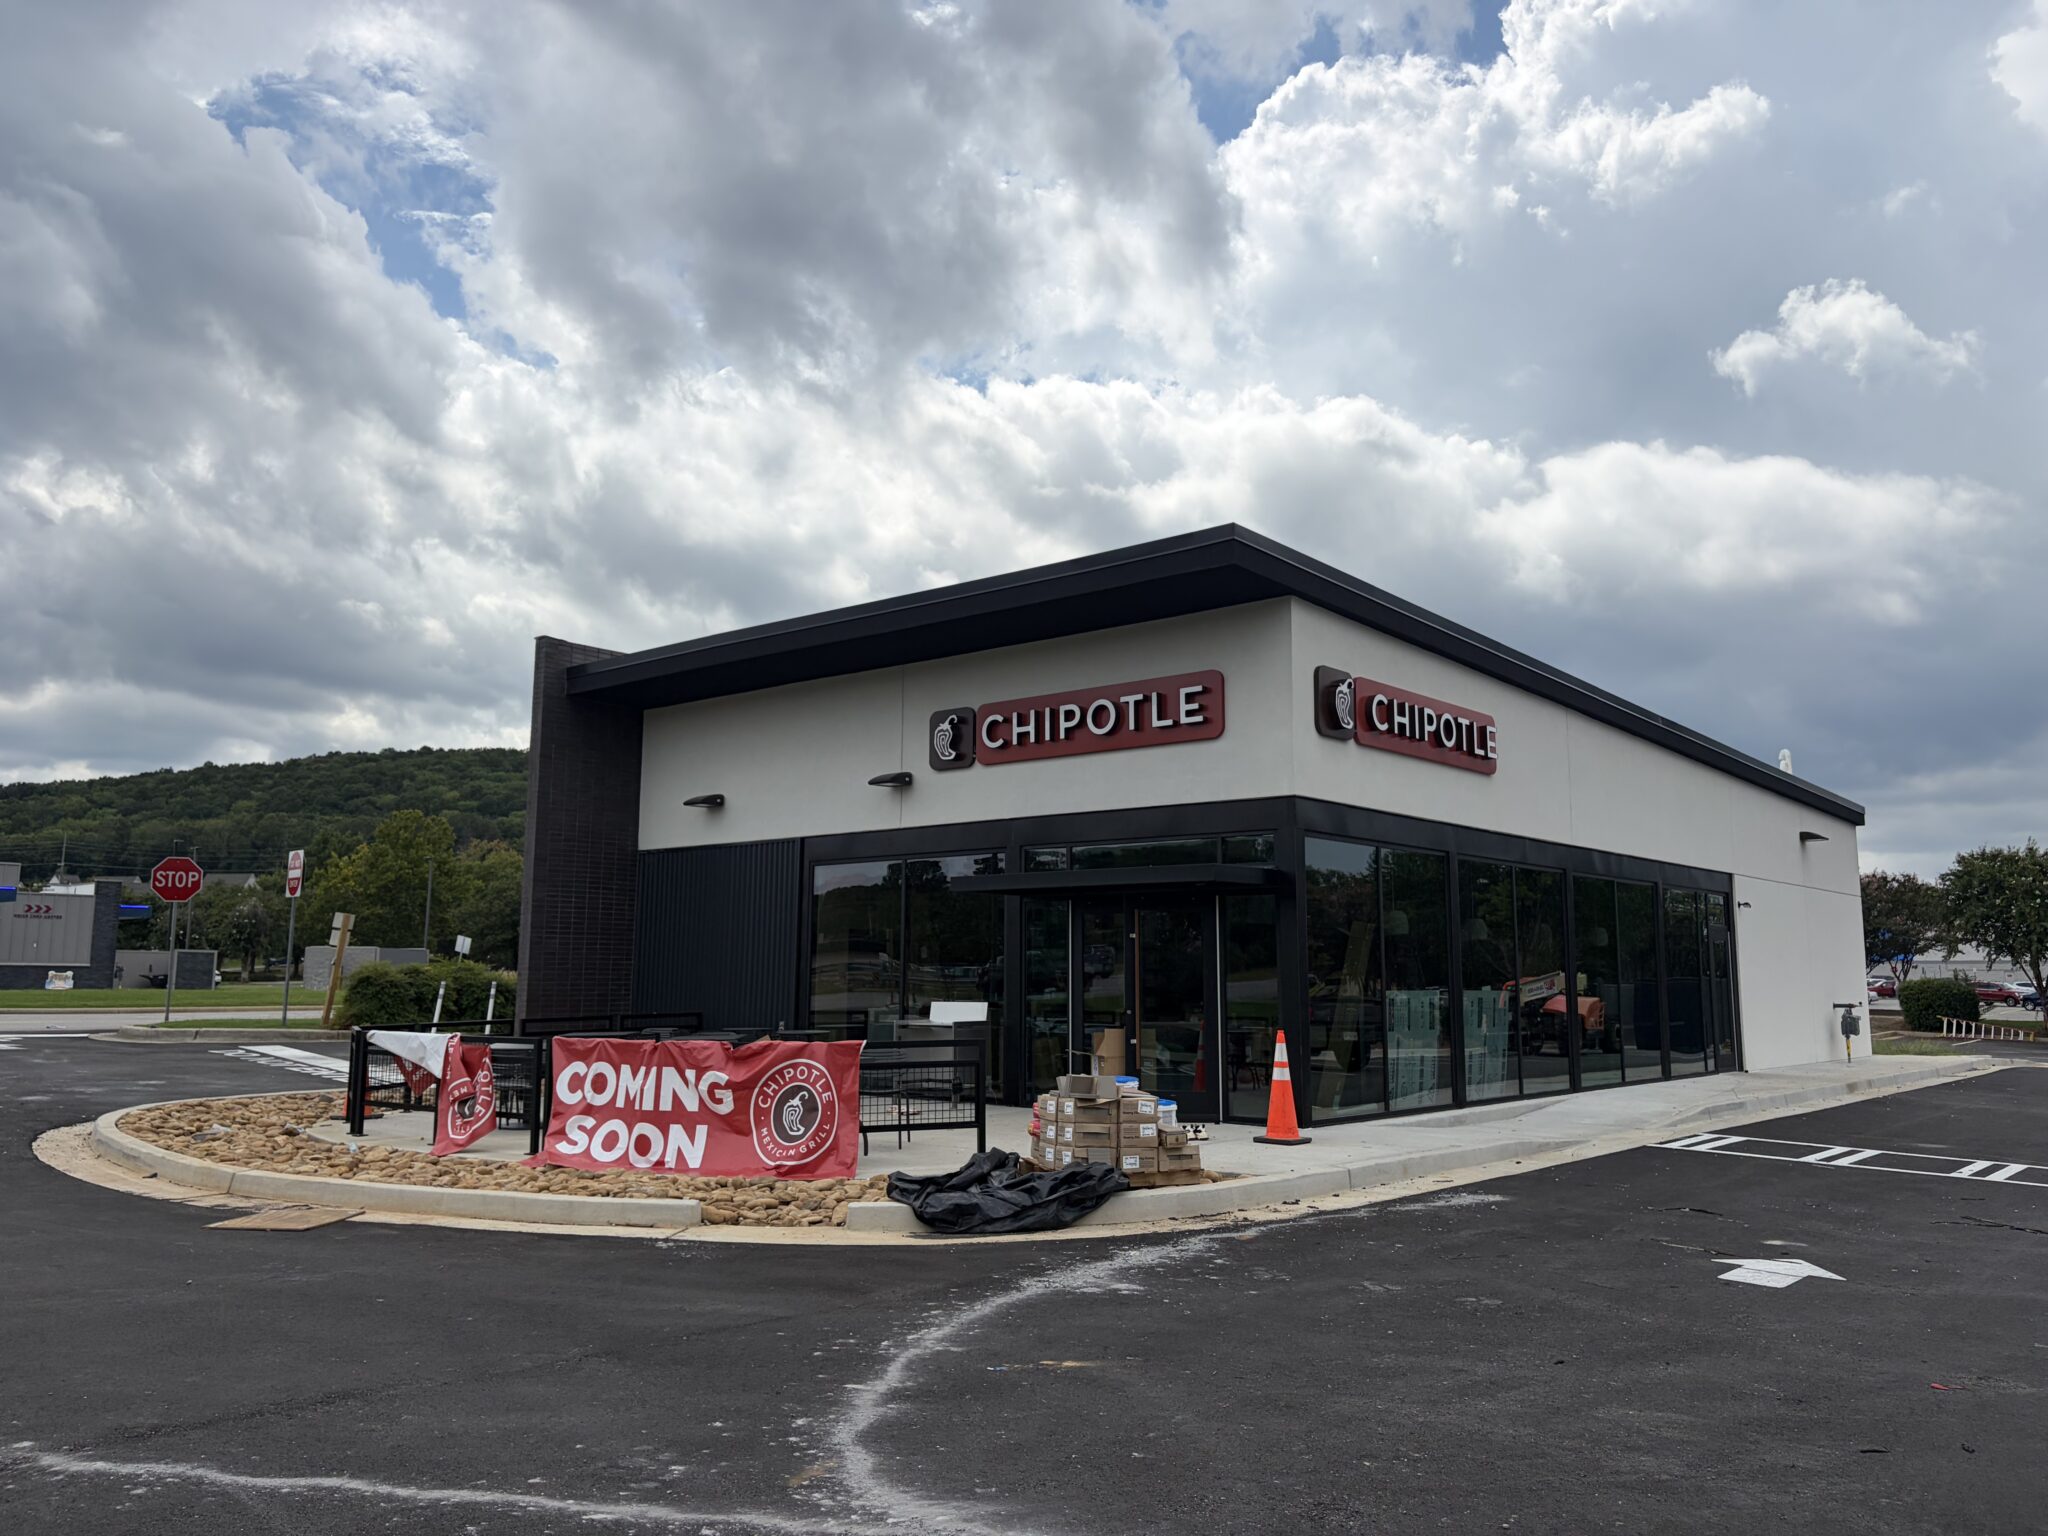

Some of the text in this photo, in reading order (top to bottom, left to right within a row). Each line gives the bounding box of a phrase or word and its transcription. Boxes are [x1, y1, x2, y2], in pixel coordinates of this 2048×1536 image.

[981, 685, 1204, 748] CHIPOTLE
[1372, 693, 1497, 759] CHIPOTLE
[154, 870, 199, 888] STOP
[556, 1061, 735, 1115] COMING
[758, 1066, 833, 1108] CHIPOTLE
[555, 1115, 708, 1169] SOON
[800, 1124, 830, 1153] GRILL
